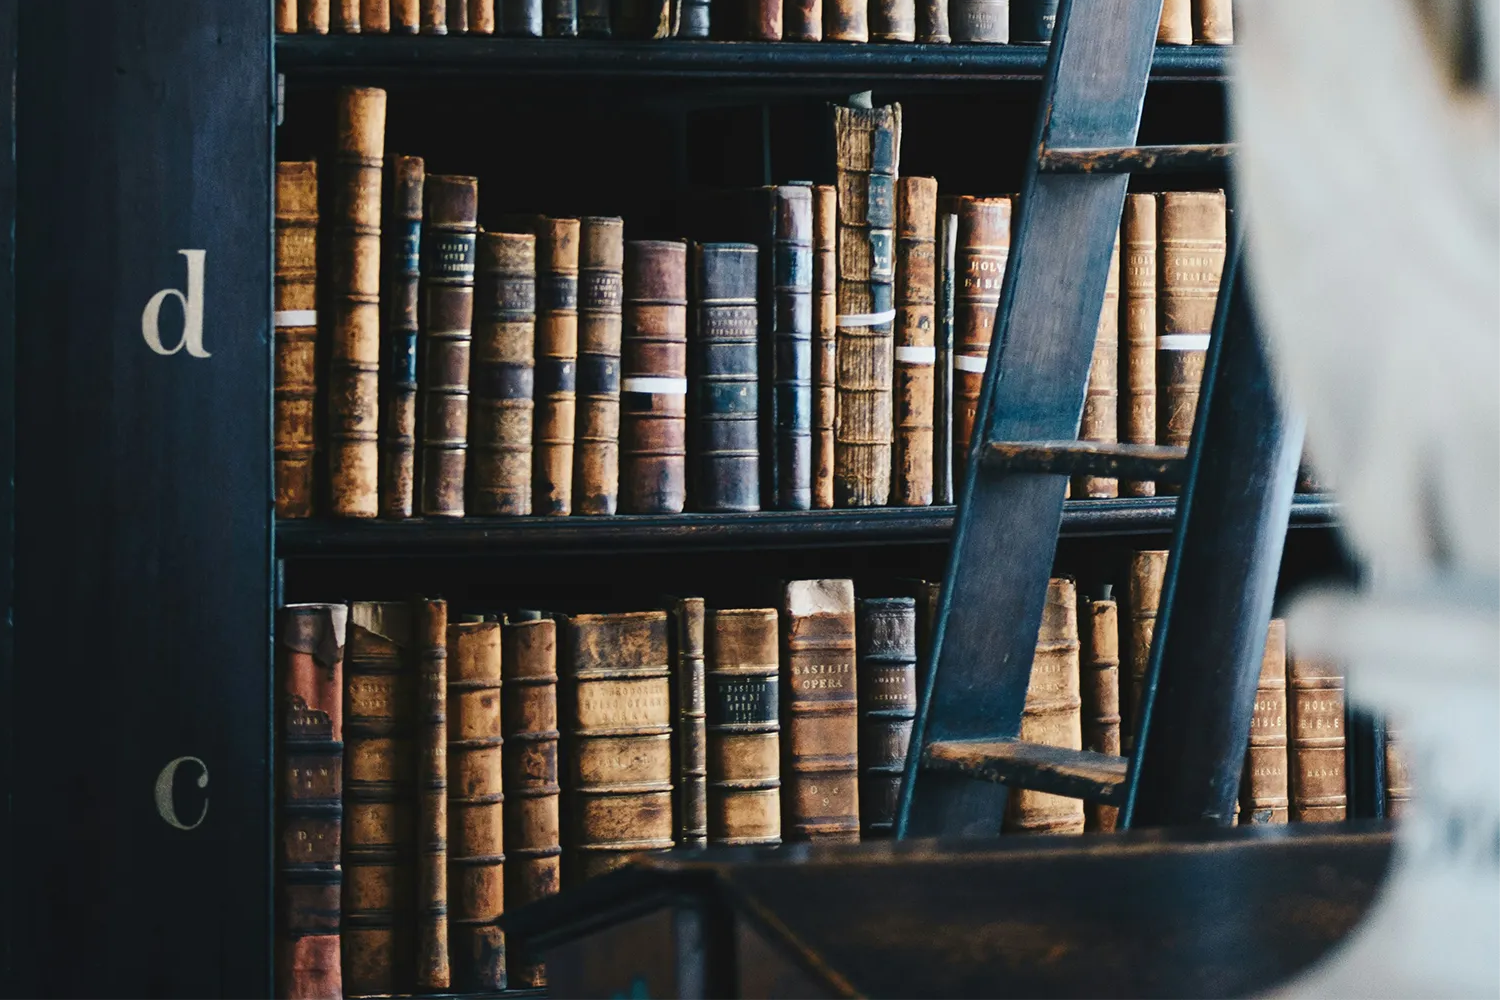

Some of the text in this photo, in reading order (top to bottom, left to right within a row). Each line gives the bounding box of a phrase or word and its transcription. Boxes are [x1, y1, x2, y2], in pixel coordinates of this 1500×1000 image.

[971, 261, 1003, 273] HOLY
[1175, 257, 1214, 267] COMMON
[965, 278, 1000, 290] BIBL
[142, 249, 211, 358] d
[794, 664, 849, 675] BASILII
[803, 679, 843, 689] OPERA
[1254, 700, 1278, 711] HOLY
[1304, 700, 1333, 711] HOLY
[1250, 717, 1281, 728] BIBLE
[1301, 718, 1339, 729] BIBLE
[155, 755, 208, 830] c
[811, 786, 818, 794] D
